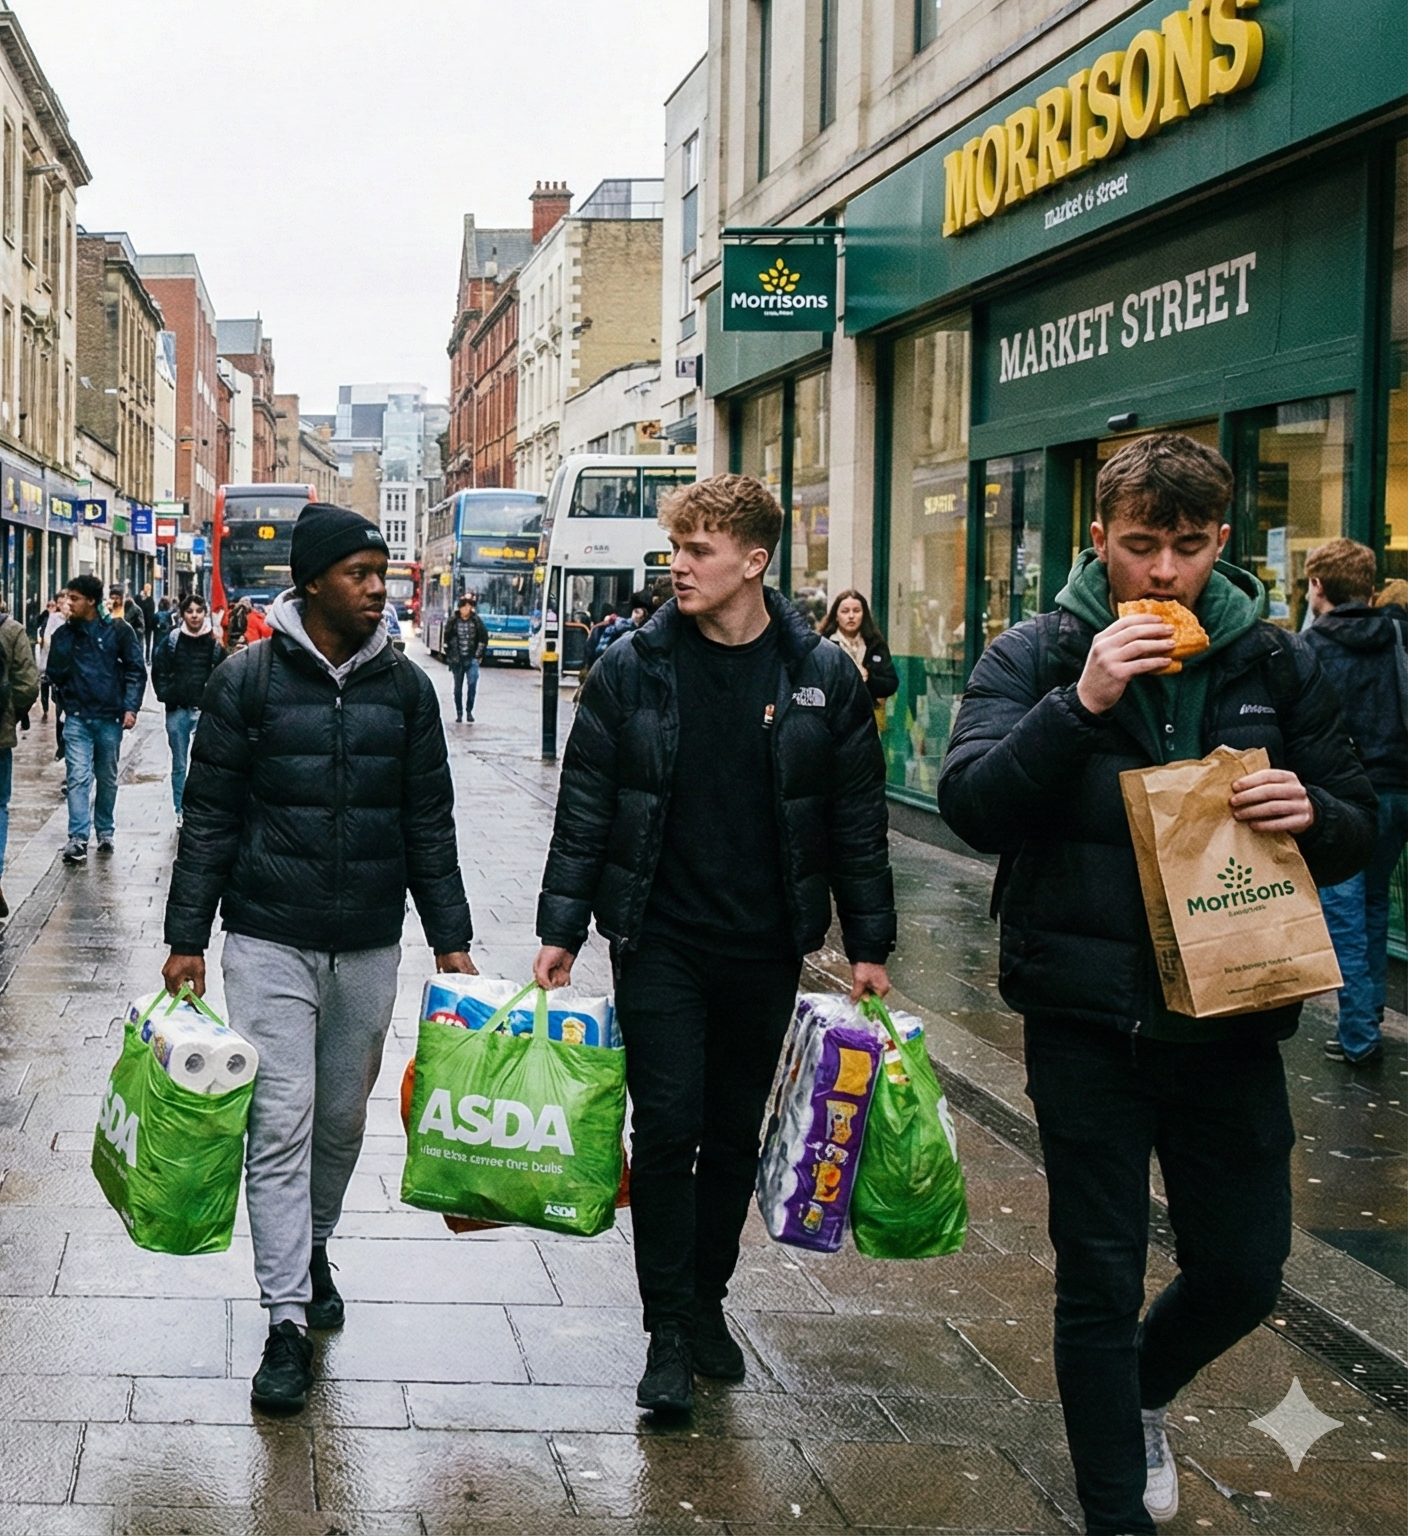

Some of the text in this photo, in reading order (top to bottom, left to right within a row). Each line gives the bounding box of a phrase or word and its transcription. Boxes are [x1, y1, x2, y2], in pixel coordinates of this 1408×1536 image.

[943, 0, 1264, 238] MORRISONS
[731, 288, 829, 309] Morrisons
[999, 251, 1257, 383] MARKET STREET
[1186, 879, 1295, 917] Morrisons
[99, 1079, 140, 1169] SDA
[417, 1088, 576, 1156] ASDA
